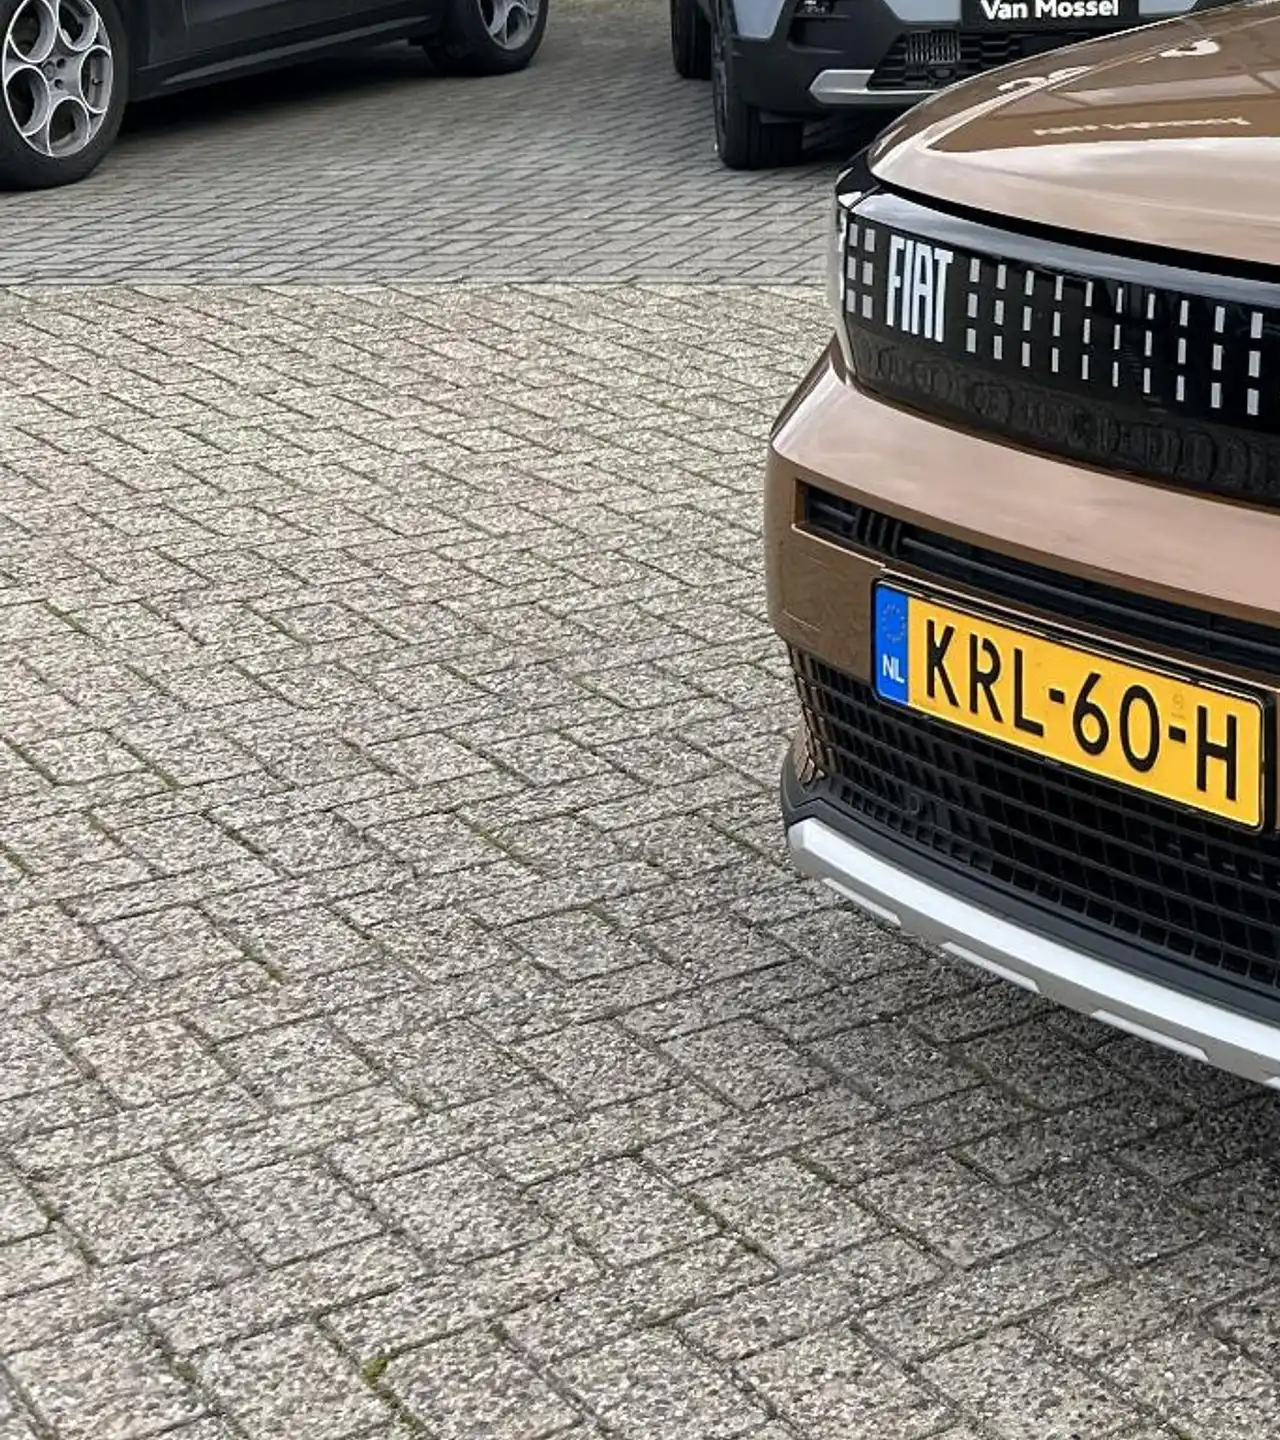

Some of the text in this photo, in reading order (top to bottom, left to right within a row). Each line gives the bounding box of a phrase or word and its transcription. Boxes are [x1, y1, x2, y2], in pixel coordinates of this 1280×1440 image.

[886, 234, 954, 343] FIAT
[882, 618, 1237, 802] NL KRL-60-H
